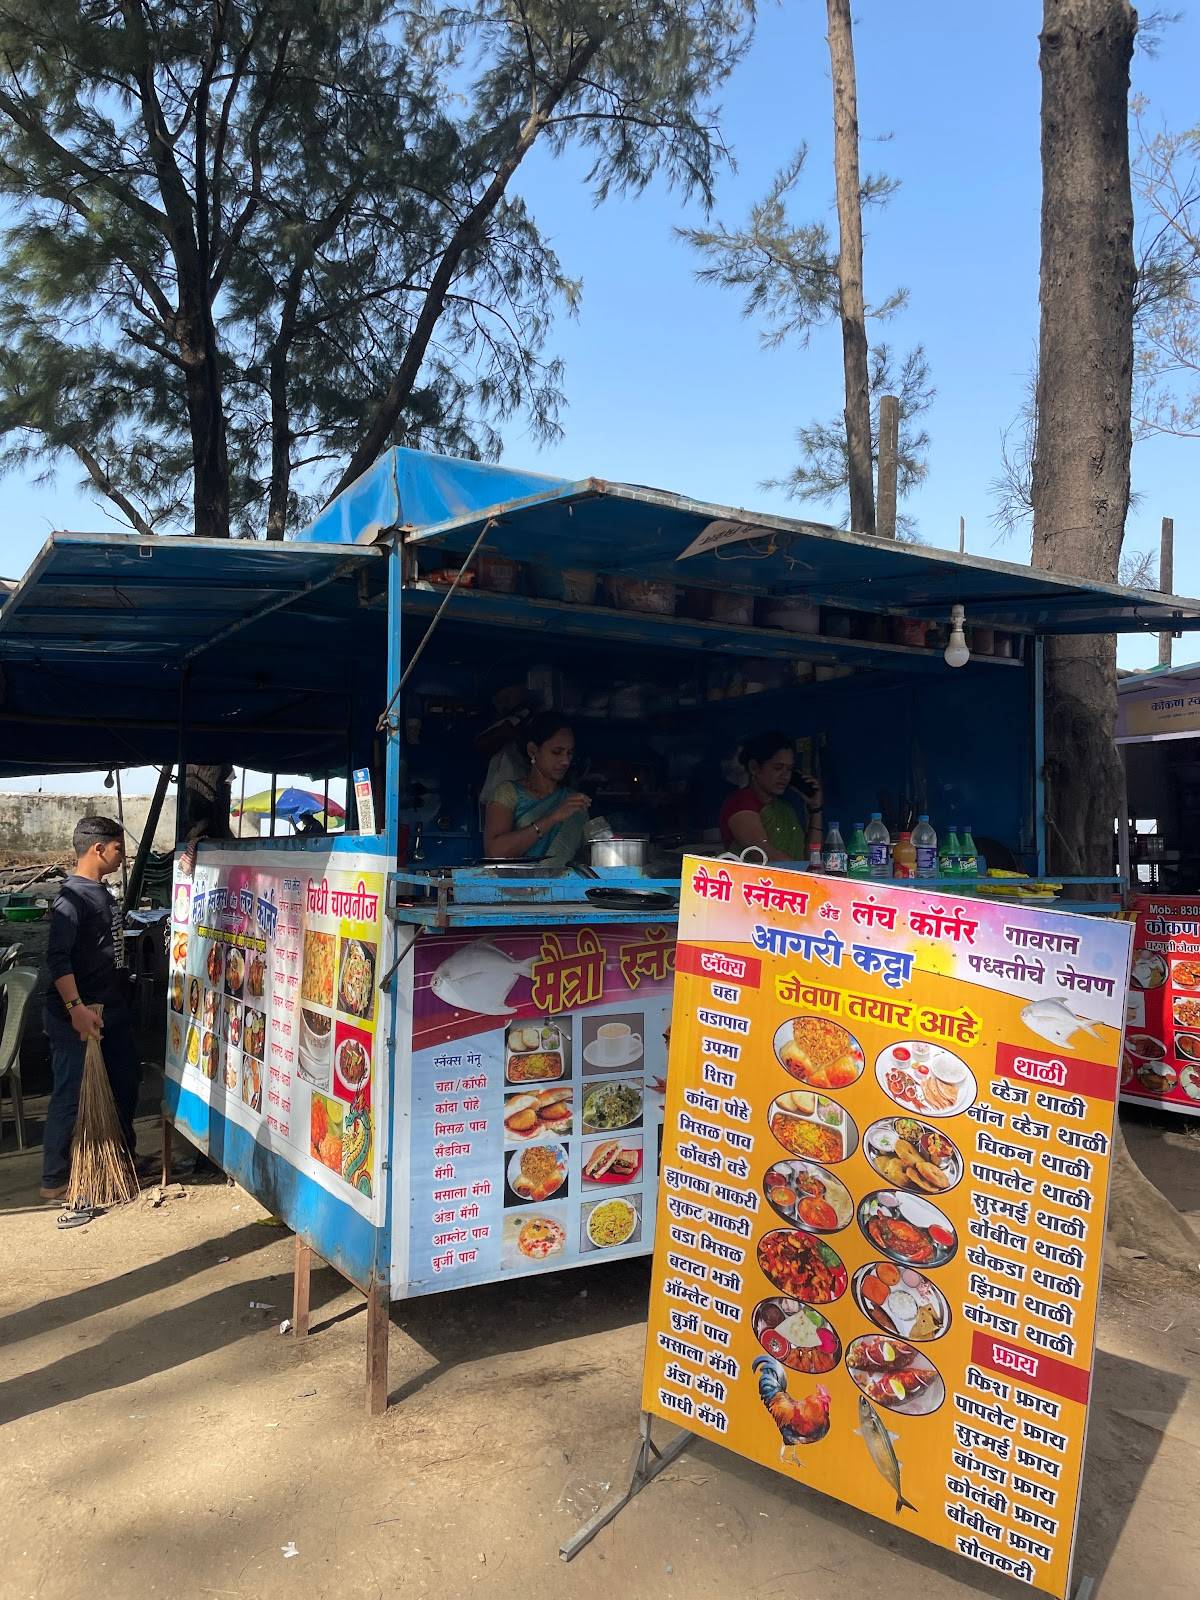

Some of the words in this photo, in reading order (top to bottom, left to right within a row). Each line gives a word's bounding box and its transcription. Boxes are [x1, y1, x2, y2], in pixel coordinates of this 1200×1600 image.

[306, 877, 329, 915] विधी
[331, 880, 379, 922] चायनीज
[692, 866, 733, 902] मैत्री
[743, 878, 809, 915] स्नॅक्स
[851, 895, 897, 930] लंच
[909, 905, 978, 945] कॉर्नर
[1180, 905, 1200, 915] 830
[1005, 926, 1080, 955] गावरान
[1145, 915, 1199, 937] कोकण
[532, 927, 606, 1014] मैत्री
[702, 953, 744, 976] स्नॅक्स
[751, 925, 844, 966] आगरी
[852, 944, 914, 988] कट्टा
[712, 984, 739, 1002] चहा
[968, 954, 1046, 985] पध्दतीचे
[1056, 964, 1115, 997] जेवण
[699, 1009, 749, 1033] वडापाव
[778, 975, 841, 1012] जेवण
[848, 994, 913, 1027] तयार
[919, 1010, 978, 1043] आहे
[433, 1053, 462, 1068] स्नॅक्स
[466, 1051, 482, 1068] मेनू
[703, 1039, 739, 1059] उपमा
[704, 1063, 735, 1087] शिरा
[1015, 1058, 1066, 1083] थाळी
[435, 1099, 458, 1115] कांदा
[463, 1096, 480, 1111] पोहे
[686, 1090, 719, 1111] कांदा
[724, 1098, 750, 1121] पोहे
[991, 1079, 1029, 1104] व्हेज
[1036, 1093, 1086, 1118] थाळी
[435, 1121, 465, 1136] मिसळ
[469, 1120, 487, 1132] पाव
[680, 1113, 722, 1140] मिसळ
[726, 1131, 752, 1150] पाव
[967, 1103, 1005, 1127] नॉन
[1011, 1113, 1050, 1139] व्हेज
[1057, 1128, 1108, 1154] थाळी
[434, 1163, 454, 1180] मॅगी
[679, 1143, 722, 1169] कोंबडी
[727, 1159, 748, 1177] वडे
[977, 1132, 1034, 1165] चिकन
[1041, 1153, 1091, 1180] थाळी
[433, 1187, 468, 1201] मसाला
[471, 1180, 491, 1196] मॅगी
[666, 1168, 711, 1194] झुणका
[715, 1184, 758, 1210] भाकरी
[972, 1163, 1035, 1194] पापलेट
[1042, 1183, 1092, 1211] थाळी
[434, 1210, 455, 1223] अंडा
[460, 1203, 479, 1219] मॅगी
[668, 1197, 704, 1220] सुकट
[707, 1210, 750, 1237] भाकरी
[972, 1192, 1029, 1224] सुरमई
[1036, 1211, 1086, 1239] थाळी
[471, 1227, 489, 1239] पाव
[671, 1226, 696, 1246] वडा
[700, 1233, 744, 1263] मिसळ
[458, 1250, 477, 1263] पाव
[669, 1254, 707, 1278] बटाटा
[712, 1269, 741, 1291] भजी
[967, 1246, 1025, 1280] खेकडा
[1032, 1269, 1082, 1298] थाळी
[1034, 1240, 1084, 1269] थाळी
[665, 1279, 710, 1308] ऑम्लेट
[715, 1299, 742, 1320] पाव
[969, 1273, 1017, 1306] झिंगा
[1024, 1296, 1073, 1325] थाळी
[703, 1323, 729, 1345] पाव
[964, 1304, 1019, 1336] बांगडा
[1025, 1326, 1075, 1356] थाळी
[659, 1333, 704, 1363] मसाला
[708, 1352, 738, 1377] मॅगी
[993, 1345, 1038, 1375] फ्राय
[666, 1364, 692, 1386] अंडा
[696, 1376, 725, 1401] मॅगी
[967, 1366, 1010, 1399] फिश
[1016, 1389, 1060, 1418] फ्राय
[660, 1390, 693, 1415] साधी
[698, 1405, 727, 1431] मॅगी
[955, 1395, 1017, 1430] पापलेट
[1023, 1421, 1067, 1451] फ्राय
[955, 1423, 1011, 1460] सुरमई
[1017, 1448, 1060, 1478] फ्राय
[953, 1451, 1007, 1485] बांगडा
[1013, 1475, 1056, 1506] फ्राय
[947, 1475, 1008, 1514] कोलंबी
[1014, 1505, 1057, 1535] फ्राय
[957, 1537, 1034, 1582] सोलकढी
[1008, 1531, 1052, 1562] फ्राय
